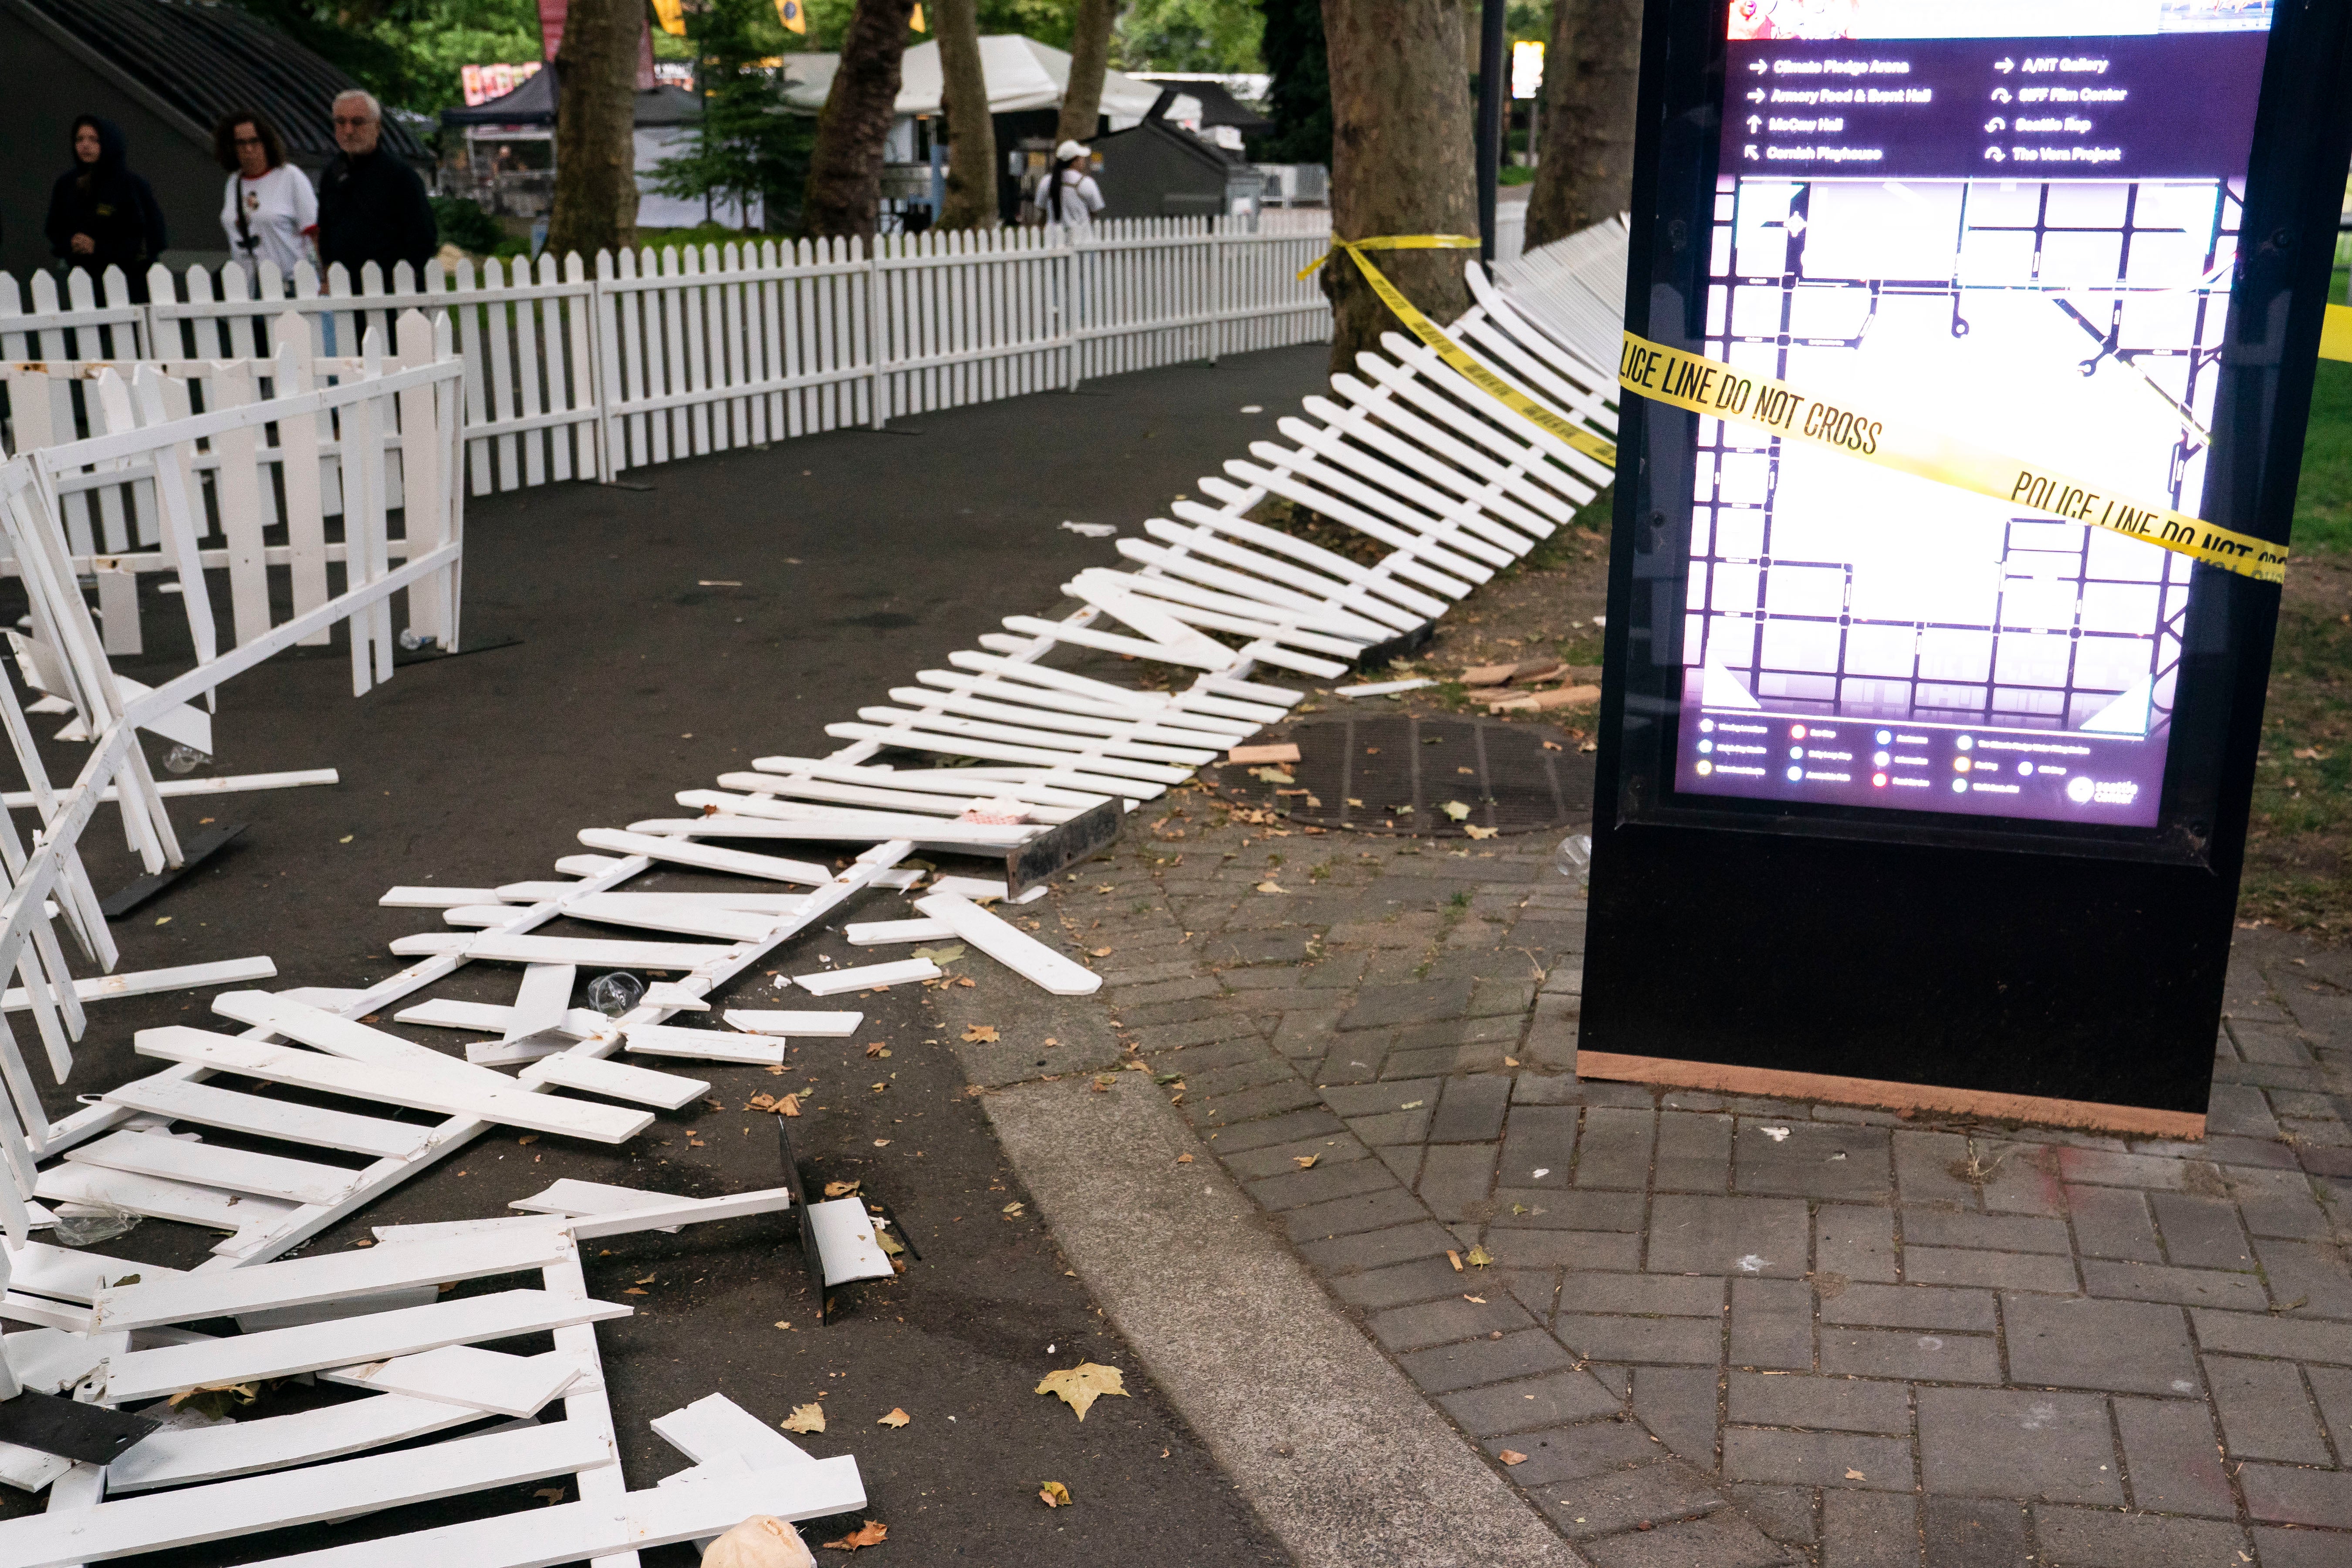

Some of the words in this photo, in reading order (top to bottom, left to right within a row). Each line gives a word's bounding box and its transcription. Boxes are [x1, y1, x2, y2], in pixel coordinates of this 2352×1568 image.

[1869, 60, 1909, 73] Arena
[2059, 58, 2108, 74] Gallery
[1771, 89, 1819, 105] Armory
[1820, 89, 1853, 102] Food
[1906, 89, 1931, 102] Hall
[2080, 88, 2127, 101] Center
[1818, 118, 1843, 131] Hall
[2012, 147, 2038, 160] The
[2072, 147, 2121, 163] Project
[1620, 340, 1662, 389] LICE
[1661, 357, 1717, 404] LINE
[1715, 373, 1751, 414] DO
[1752, 385, 1805, 430] NOT
[1803, 402, 1883, 455] CROSS
[2011, 471, 2100, 520] POLICE
